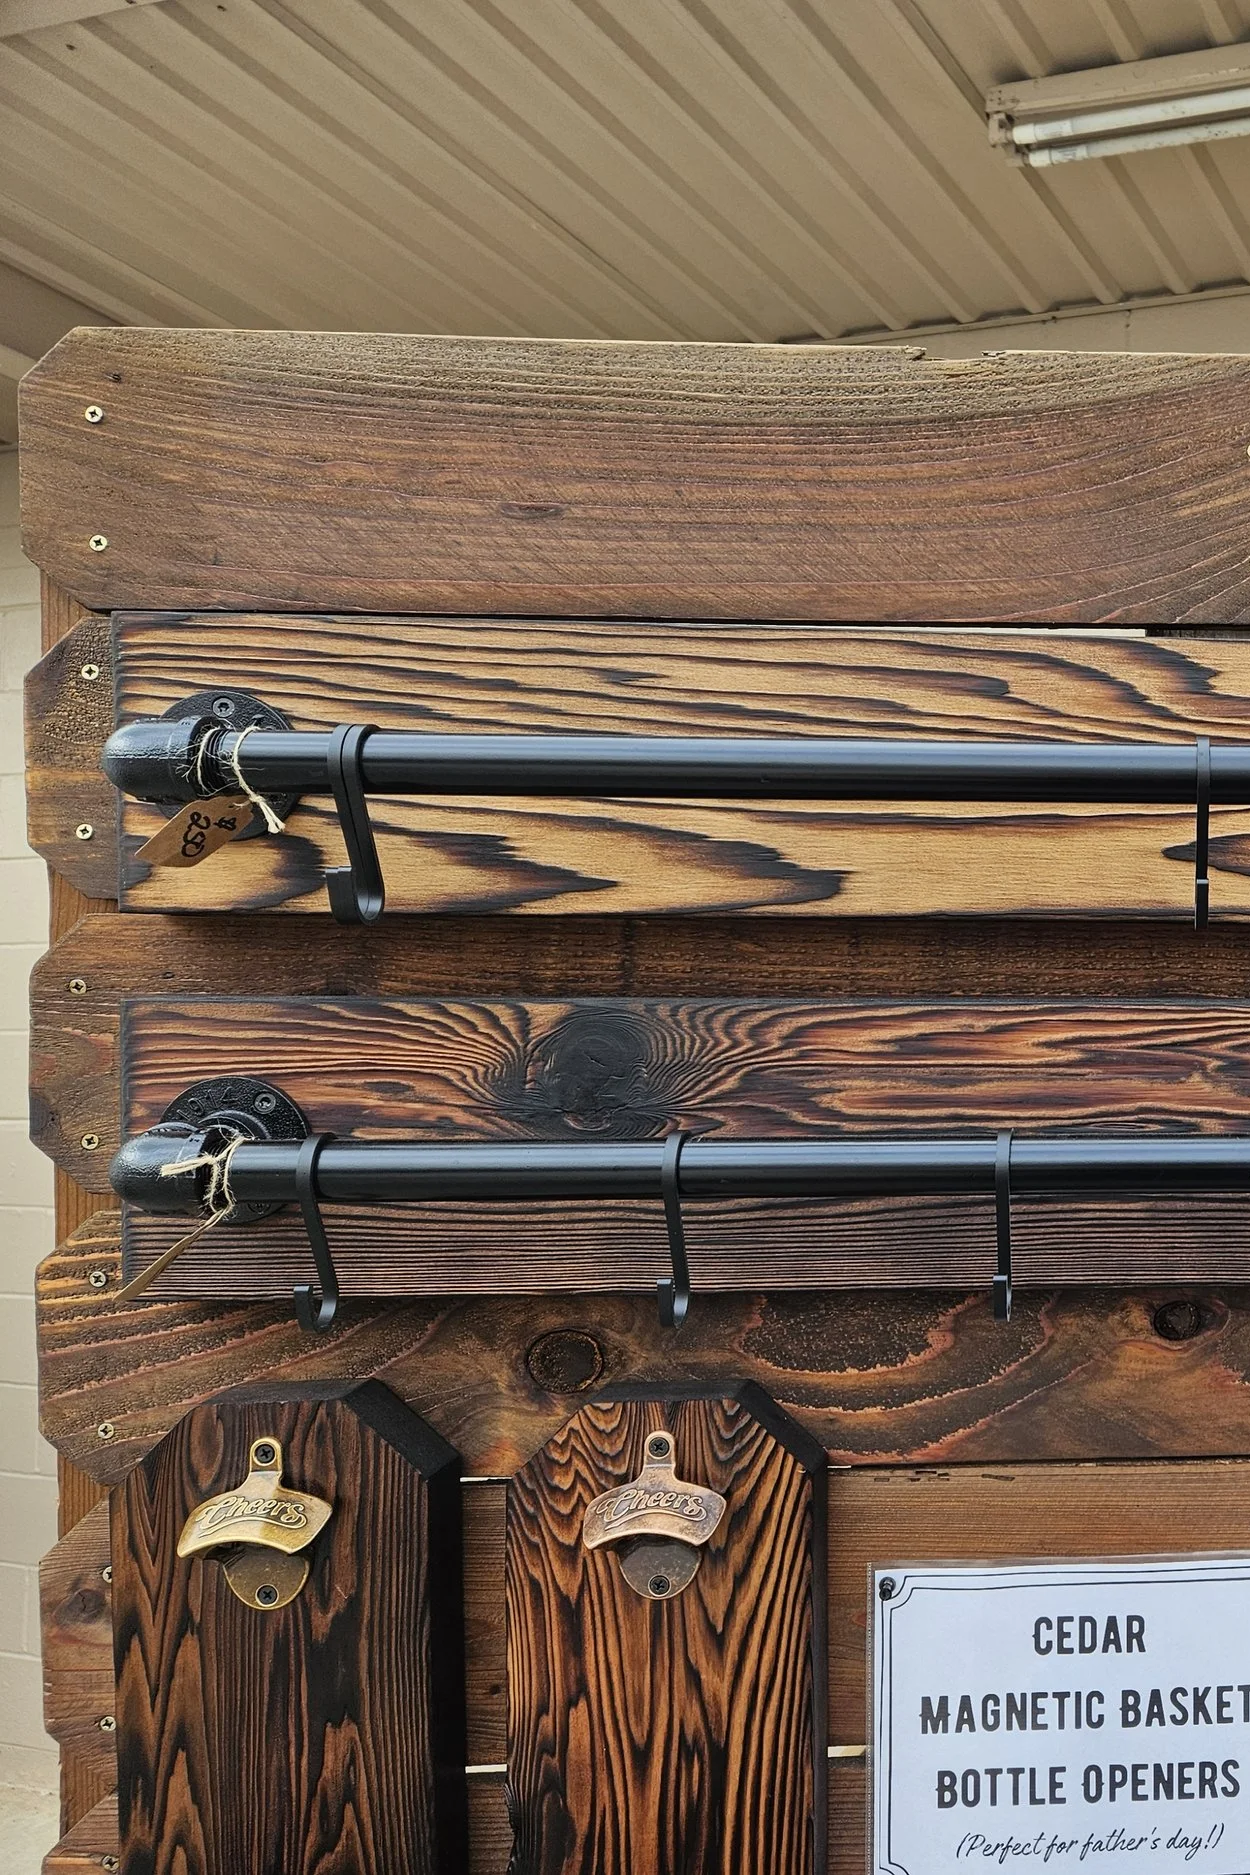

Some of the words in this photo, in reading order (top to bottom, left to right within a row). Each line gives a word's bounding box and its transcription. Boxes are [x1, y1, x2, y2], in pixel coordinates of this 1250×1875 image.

[195, 1495, 307, 1532] Cheers
[594, 1488, 707, 1525] Cheers
[1032, 1614, 1146, 1656] CEDAR
[919, 1690, 1105, 1735] MAGNETIC
[935, 1765, 1067, 1809] BOTTLE
[1081, 1759, 1241, 1803] OPENERS
[956, 1832, 1044, 1864] (Perfect
[1043, 1834, 1079, 1863] for
[1080, 1827, 1162, 1861] father's
[1166, 1822, 1225, 1861] day!)
